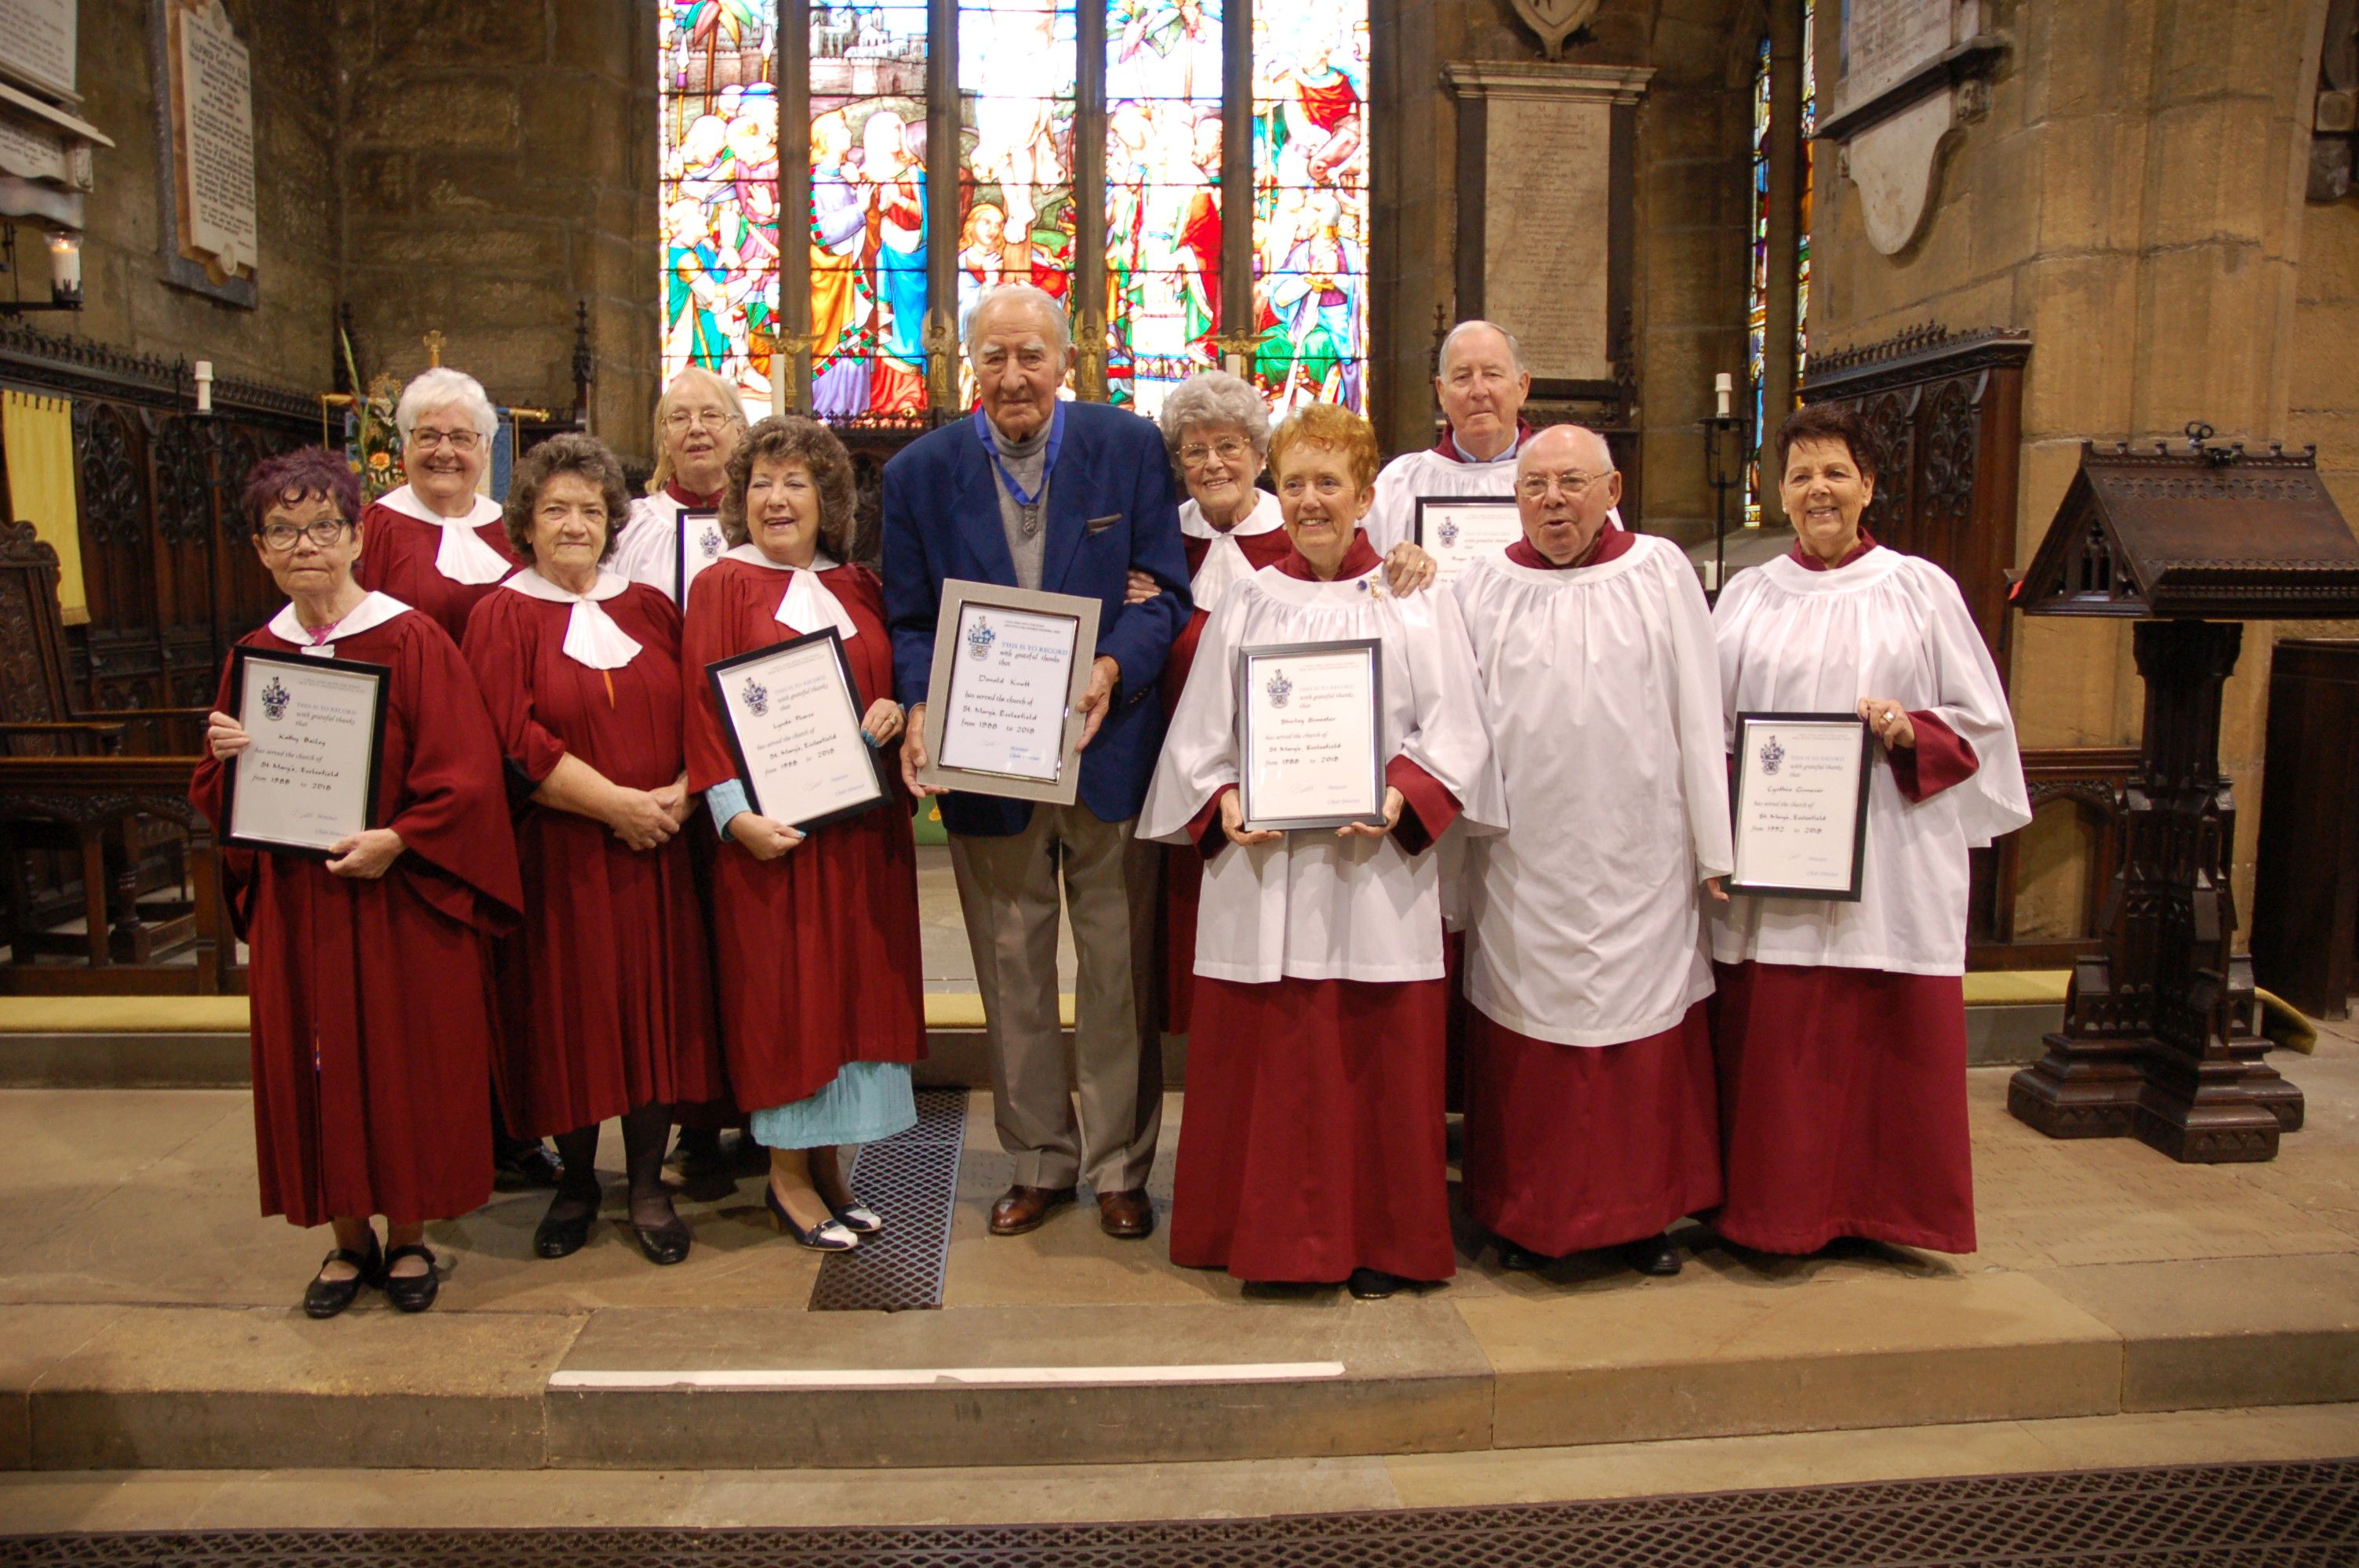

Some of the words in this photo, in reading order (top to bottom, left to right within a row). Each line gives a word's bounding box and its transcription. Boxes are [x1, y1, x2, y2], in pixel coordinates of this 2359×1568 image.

[1039, 645, 1067, 655] RECORD
[1015, 652, 1039, 660] grateful
[1041, 654, 1060, 663] thanks
[979, 674, 1004, 684] Donald
[1010, 678, 1030, 688] Knott
[976, 693, 995, 702] served
[1006, 695, 1027, 704] church
[1027, 698, 1034, 706] of
[311, 713, 334, 722] grateful
[961, 717, 976, 727] from
[979, 721, 998, 730] 1988
[1016, 726, 1035, 735] 2018
[278, 733, 299, 745] Kathy
[304, 735, 326, 749] Bailey
[296, 753, 314, 761] church
[780, 759, 798, 769] 1988
[817, 748, 835, 759] 2018
[1321, 755, 1339, 764] 2018
[312, 782, 332, 791] 2018
